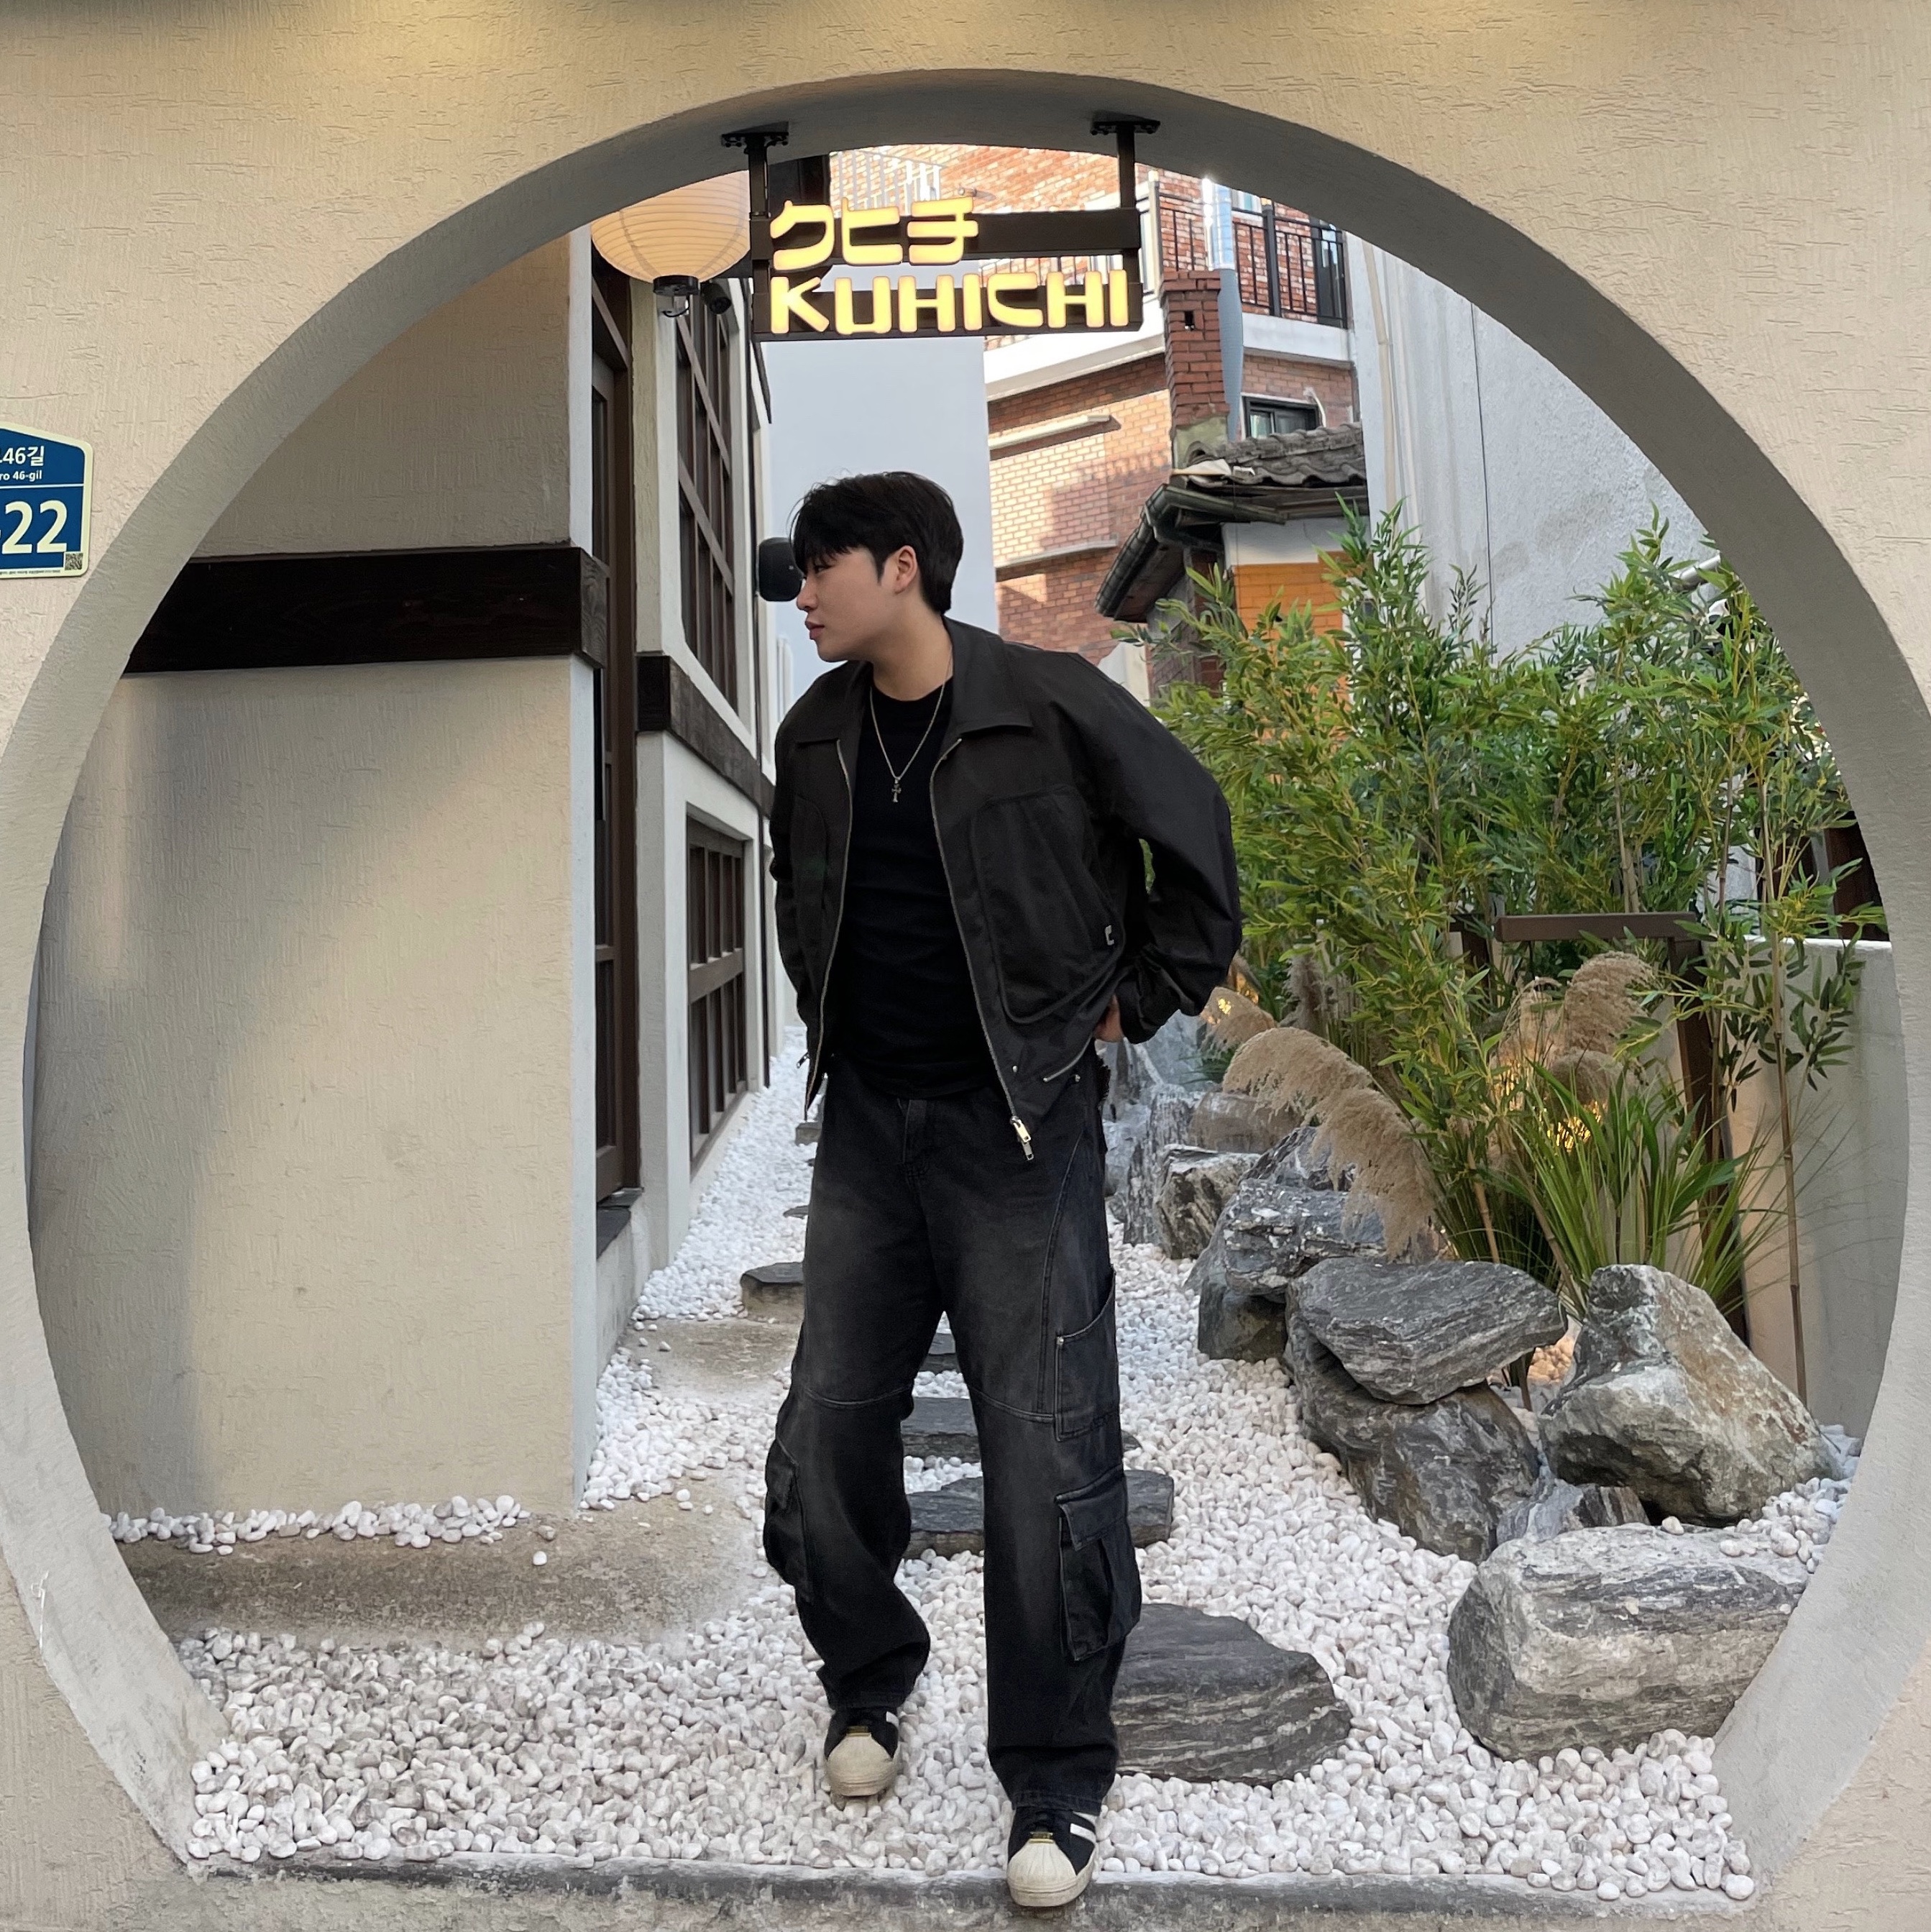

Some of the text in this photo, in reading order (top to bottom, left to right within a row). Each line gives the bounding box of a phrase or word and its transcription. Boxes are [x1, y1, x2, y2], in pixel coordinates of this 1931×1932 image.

[770, 196, 979, 270] クヒチ
[770, 270, 1129, 335] KUHICHI
[0, 445, 45, 467] 46길
[12, 470, 42, 482] 46-gil
[0, 500, 68, 554] 22
